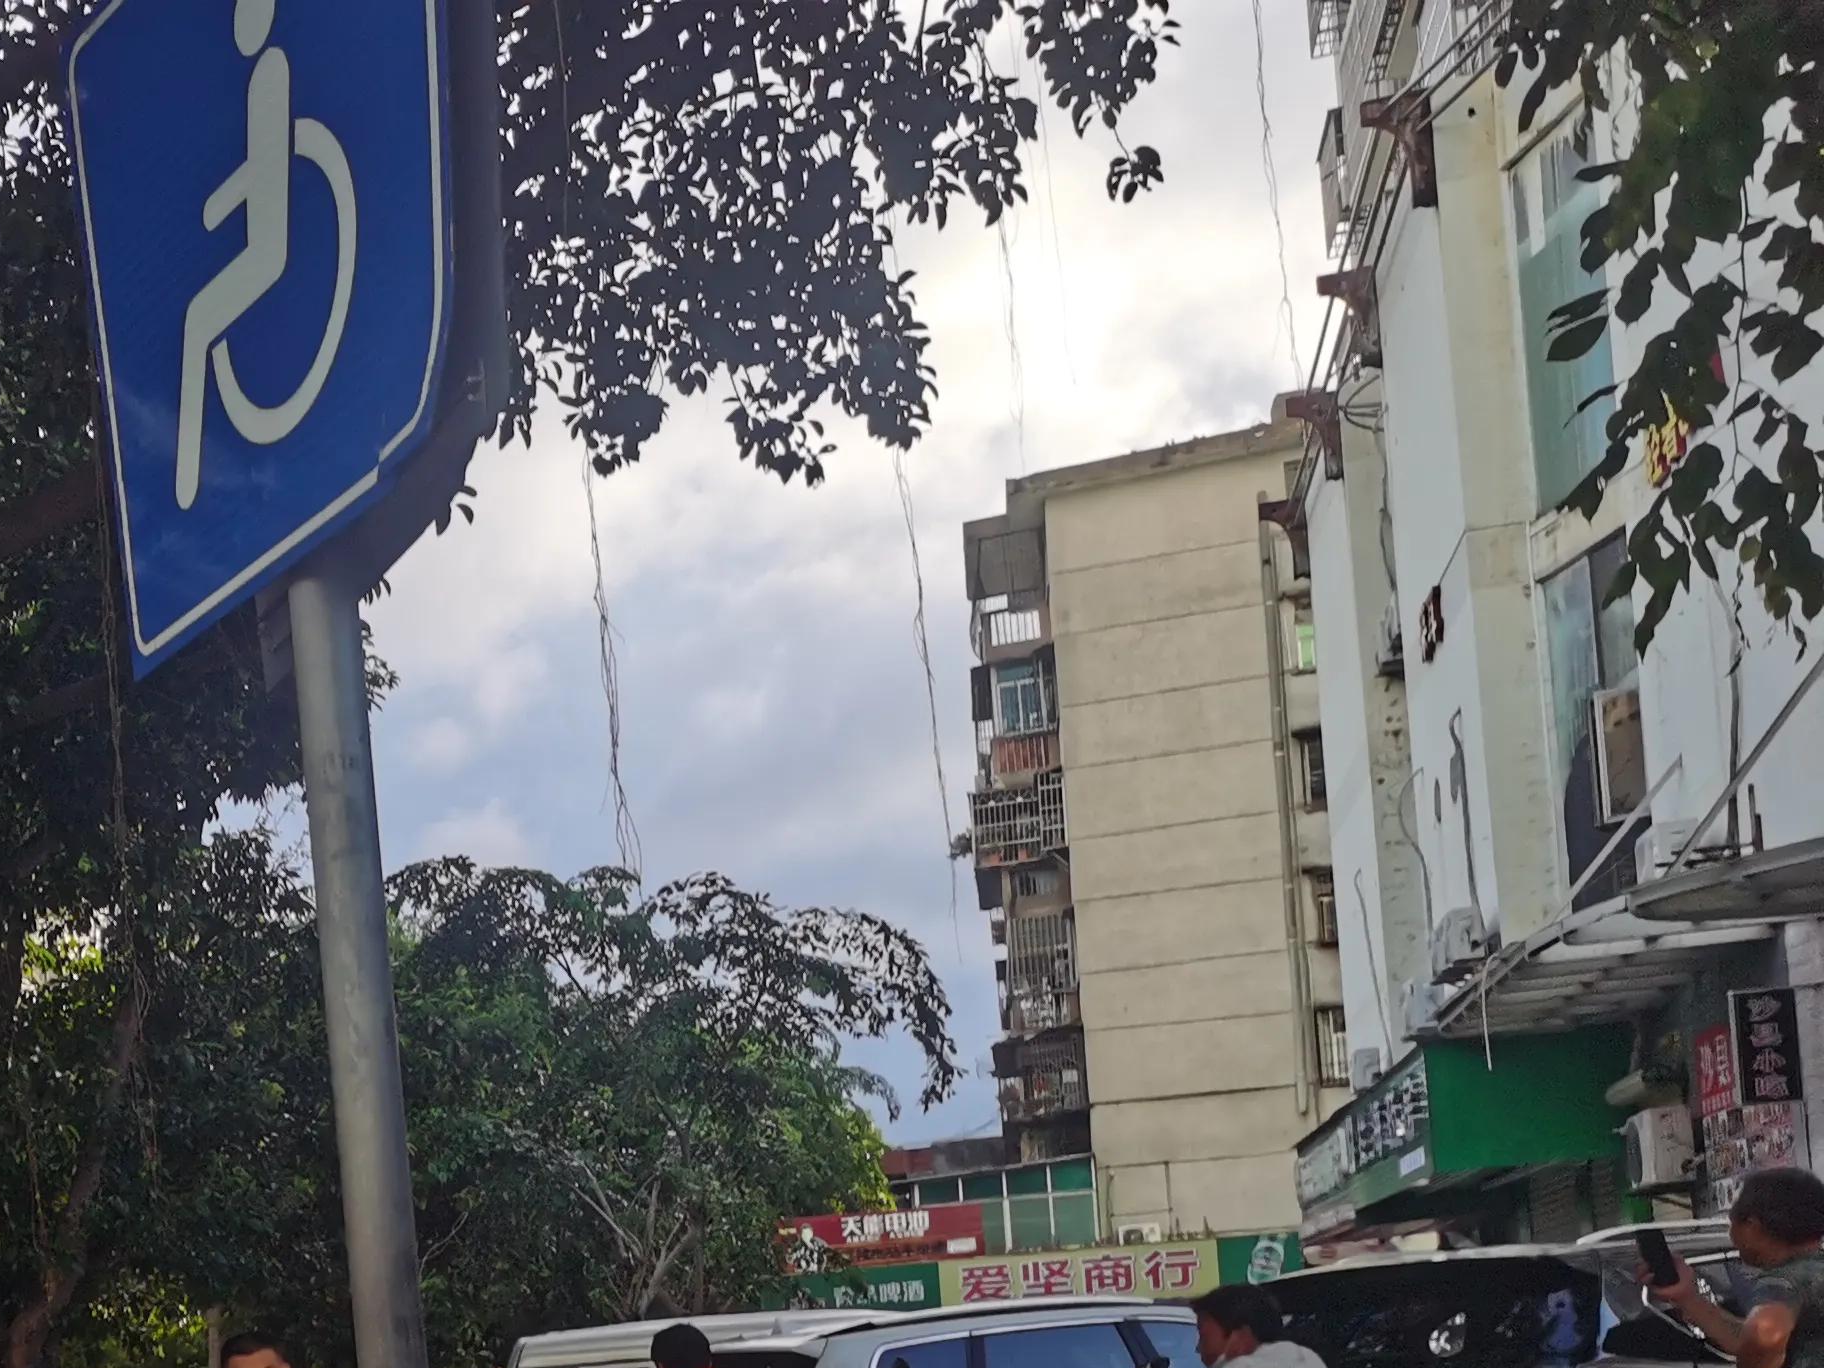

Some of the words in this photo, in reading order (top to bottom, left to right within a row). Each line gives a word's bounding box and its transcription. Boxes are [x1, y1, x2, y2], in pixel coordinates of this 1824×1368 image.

[840, 1211, 930, 1238] 天能电池
[961, 1248, 1201, 1303] 爱坚商行
